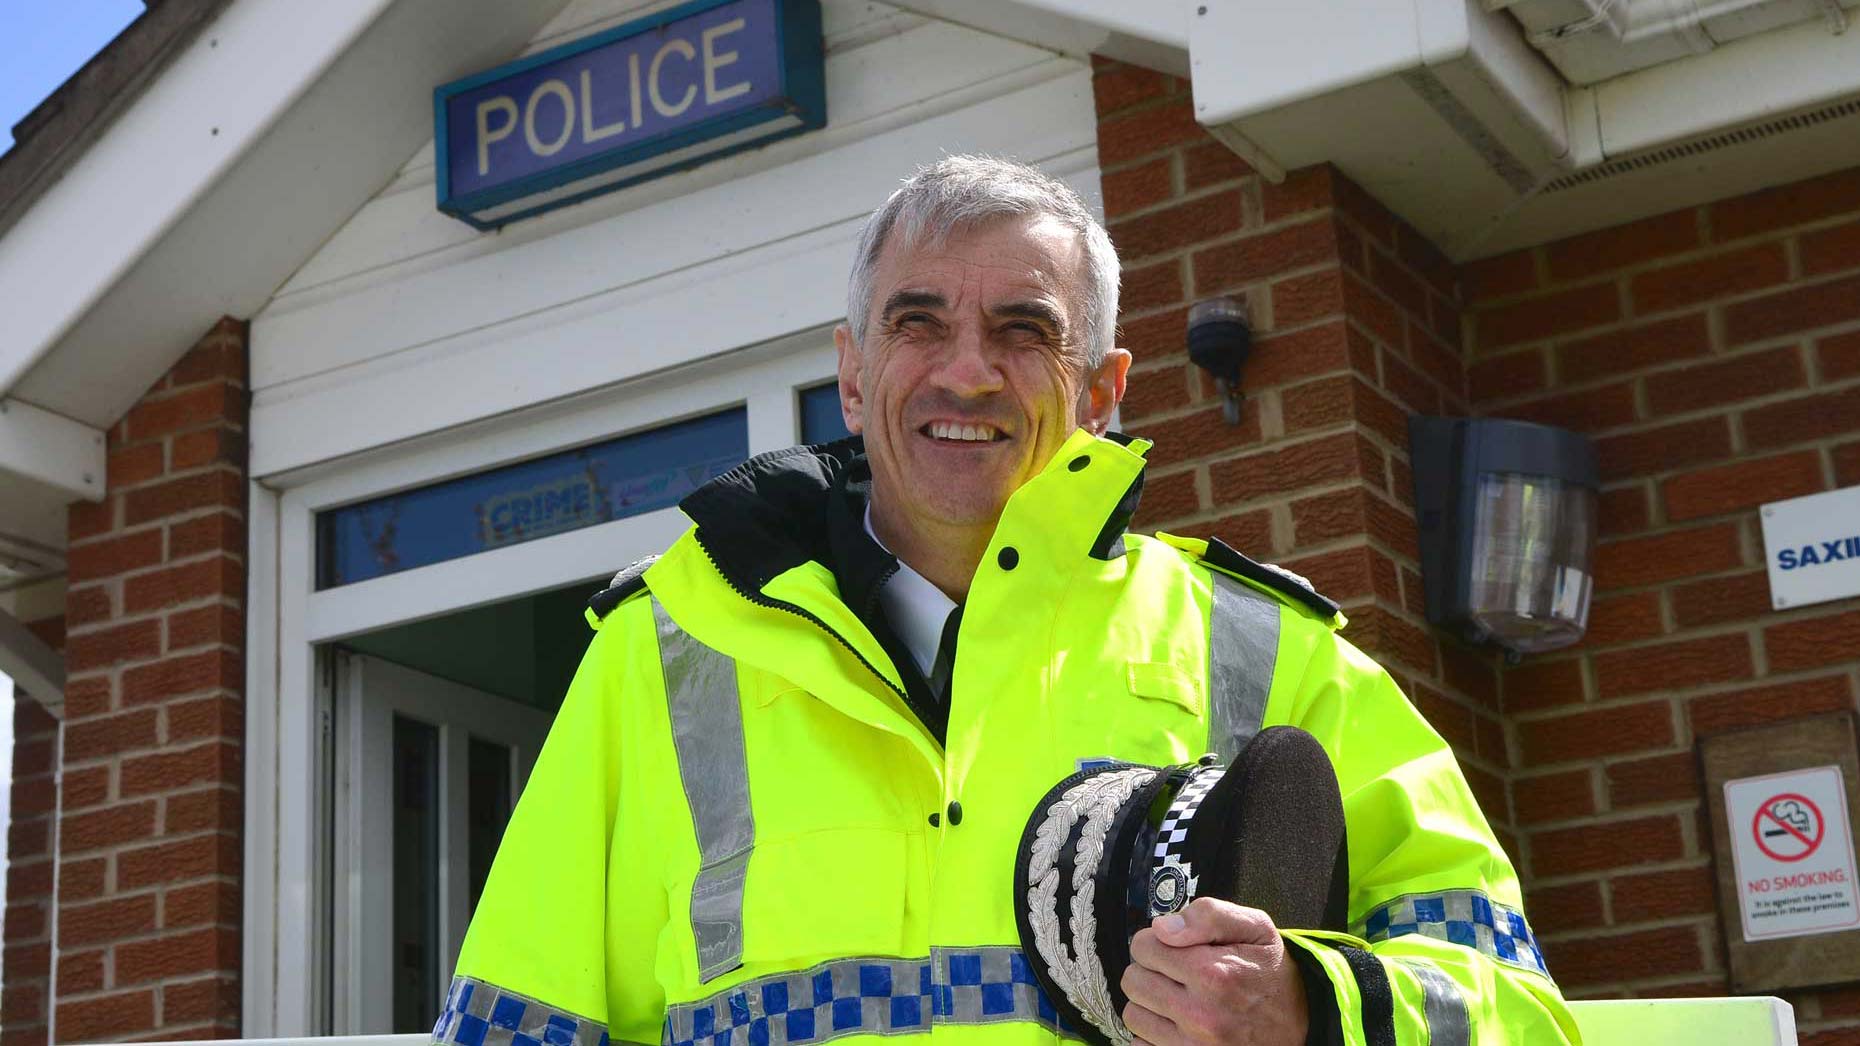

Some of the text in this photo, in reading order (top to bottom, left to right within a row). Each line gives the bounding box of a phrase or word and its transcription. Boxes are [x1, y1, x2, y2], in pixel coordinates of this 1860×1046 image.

[476, 19, 751, 176] POLICE
[491, 483, 590, 529] CRIME
[1748, 878, 1770, 893] NO
[1772, 896, 1801, 908] against
[1803, 893, 1816, 901] the
[1819, 892, 1832, 900] law
[1751, 909, 1777, 919] smoke
[1789, 904, 1811, 914] these
[1813, 901, 1850, 913] premises
